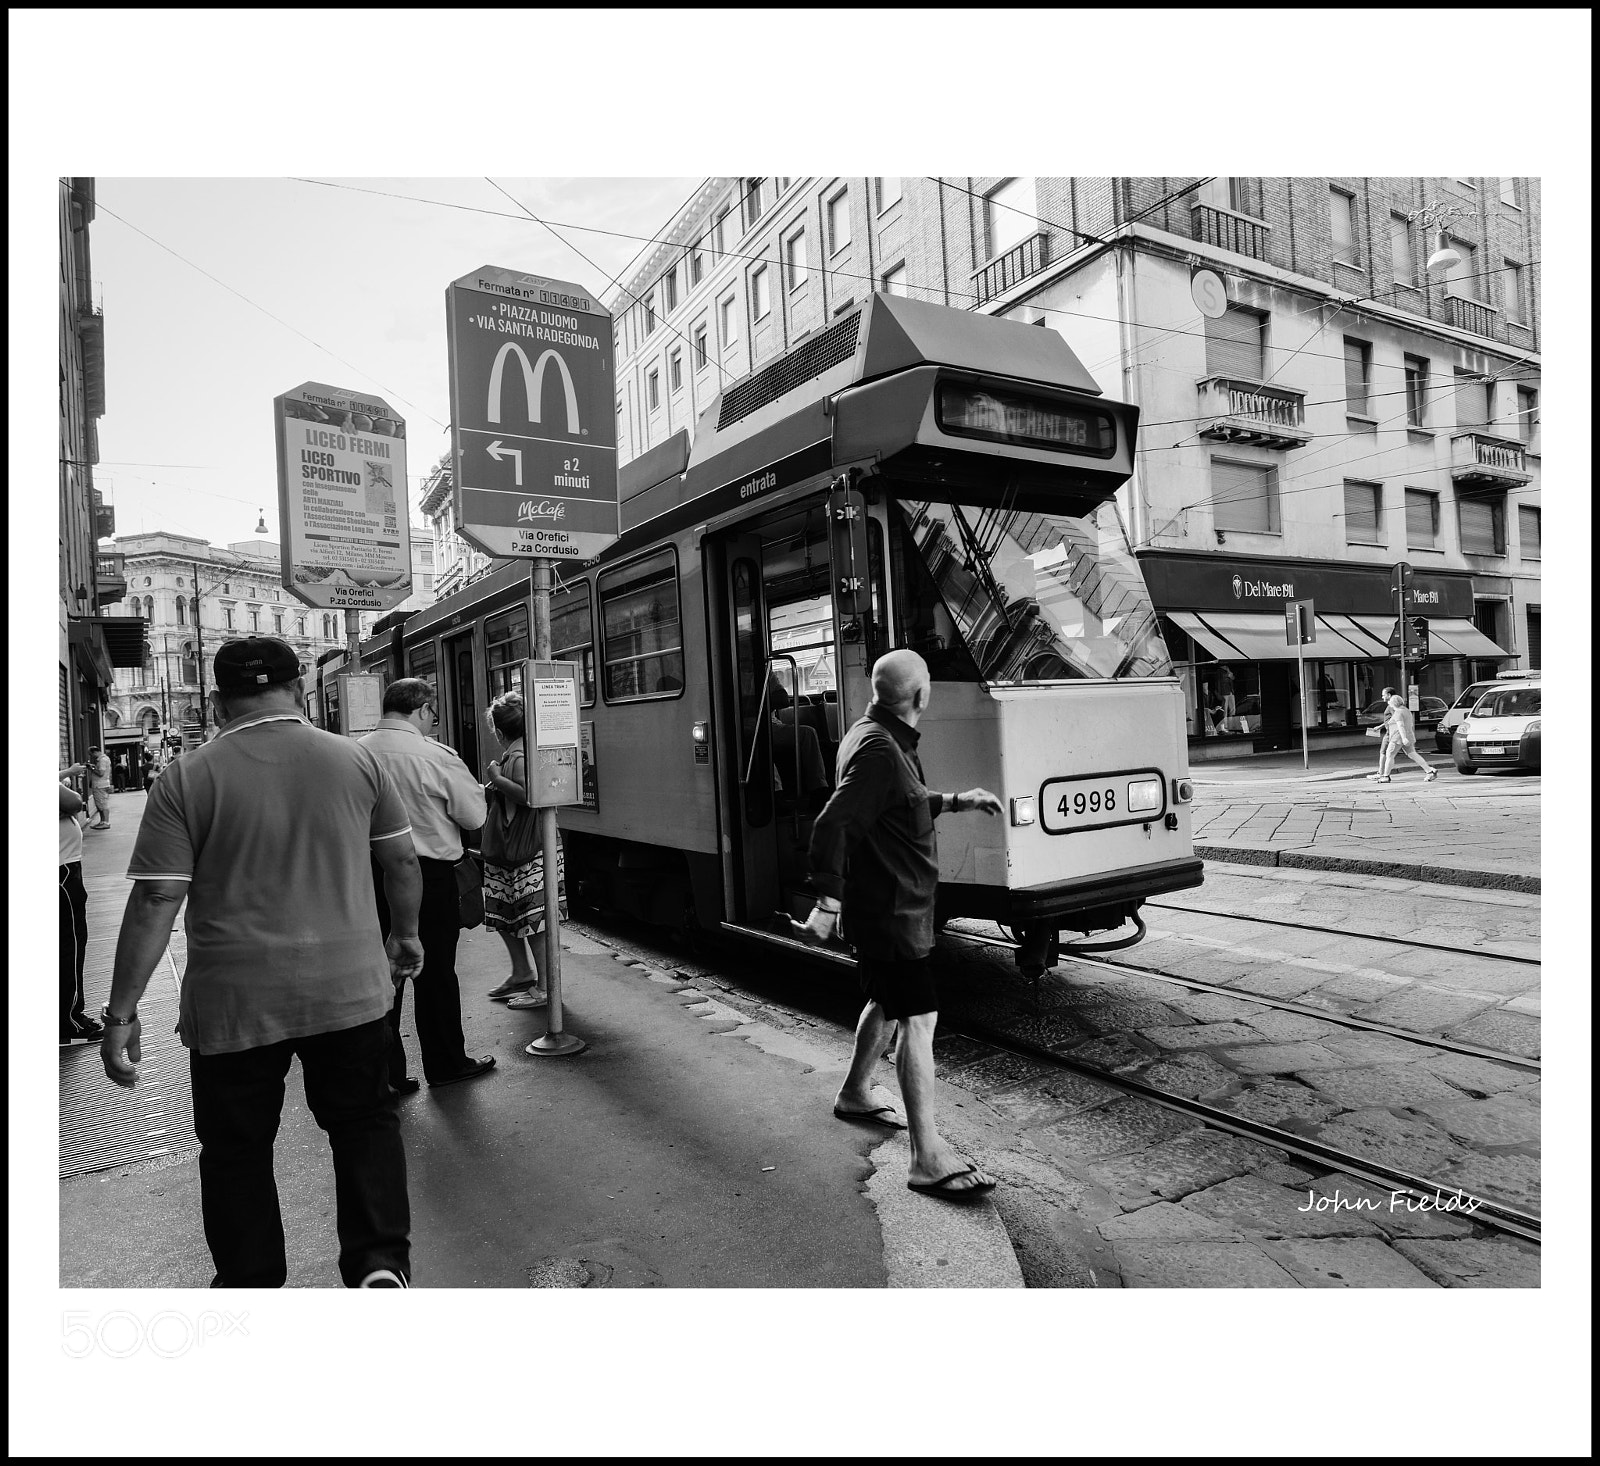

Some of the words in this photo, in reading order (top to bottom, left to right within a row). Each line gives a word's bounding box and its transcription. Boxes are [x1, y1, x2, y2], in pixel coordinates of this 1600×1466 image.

[478, 279, 521, 297] Fermata
[541, 290, 590, 311] 11491
[500, 303, 539, 323] PIAZZA
[540, 311, 578, 331] DUOMO
[476, 314, 496, 331] VIA
[498, 318, 534, 338] SANTA
[536, 326, 600, 350] RADEGONDA
[302, 392, 336, 406] Fermata
[1065, 416, 1087, 444] M3
[305, 428, 347, 451] LICEO
[349, 436, 390, 459] FERMI
[301, 449, 335, 467] LICEO
[563, 459, 571, 471] a
[572, 457, 580, 472] 2
[301, 464, 361, 486] SPORTIVO
[554, 474, 590, 489] minuti
[740, 472, 776, 499] entrata
[517, 500, 566, 523] McCafé
[519, 529, 534, 540] Via
[536, 531, 569, 542] Orefici
[512, 542, 533, 553] P.za
[534, 543, 579, 555] Cordusio
[334, 587, 347, 596] Via
[348, 588, 374, 597] Orefici
[1244, 579, 1261, 597] Del
[1261, 581, 1282, 597] Mare
[1413, 589, 1429, 603] Mare
[330, 596, 347, 605] P.za
[347, 597, 382, 607] Cordusio
[1057, 788, 1116, 817] 4998
